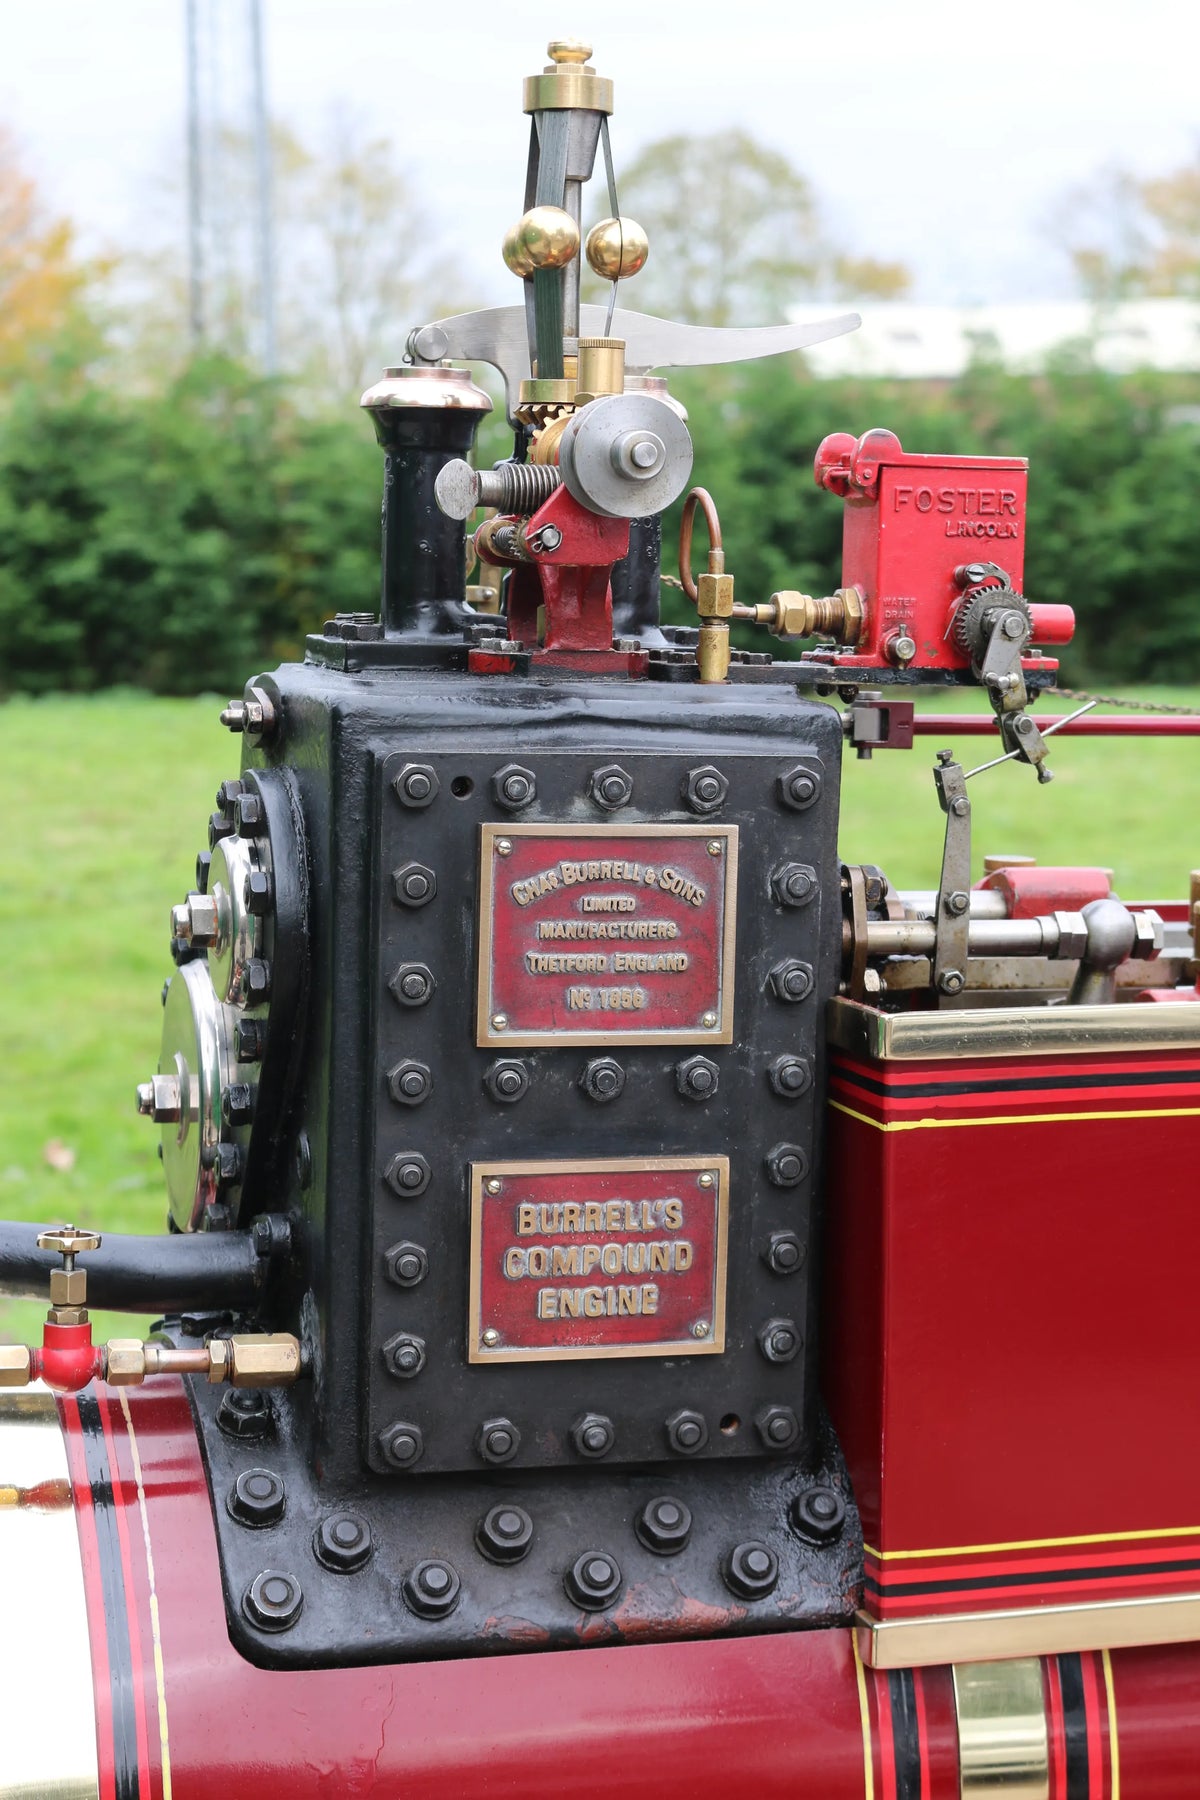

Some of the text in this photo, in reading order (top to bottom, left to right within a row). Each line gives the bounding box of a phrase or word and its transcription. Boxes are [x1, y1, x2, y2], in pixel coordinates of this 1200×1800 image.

[894, 486, 1017, 515] FOSTER
[560, 861, 640, 886] BURRELL
[643, 868, 656, 885] &
[658, 868, 706, 907] SONS
[582, 897, 636, 912] LIMITED
[538, 922, 678, 940] MANUFACTURERS
[527, 953, 689, 974] THETFORD ENGLAND
[518, 1201, 683, 1235] BURRELL'S
[505, 1242, 693, 1278] COMPOUND
[539, 1285, 659, 1319] ENGINE
